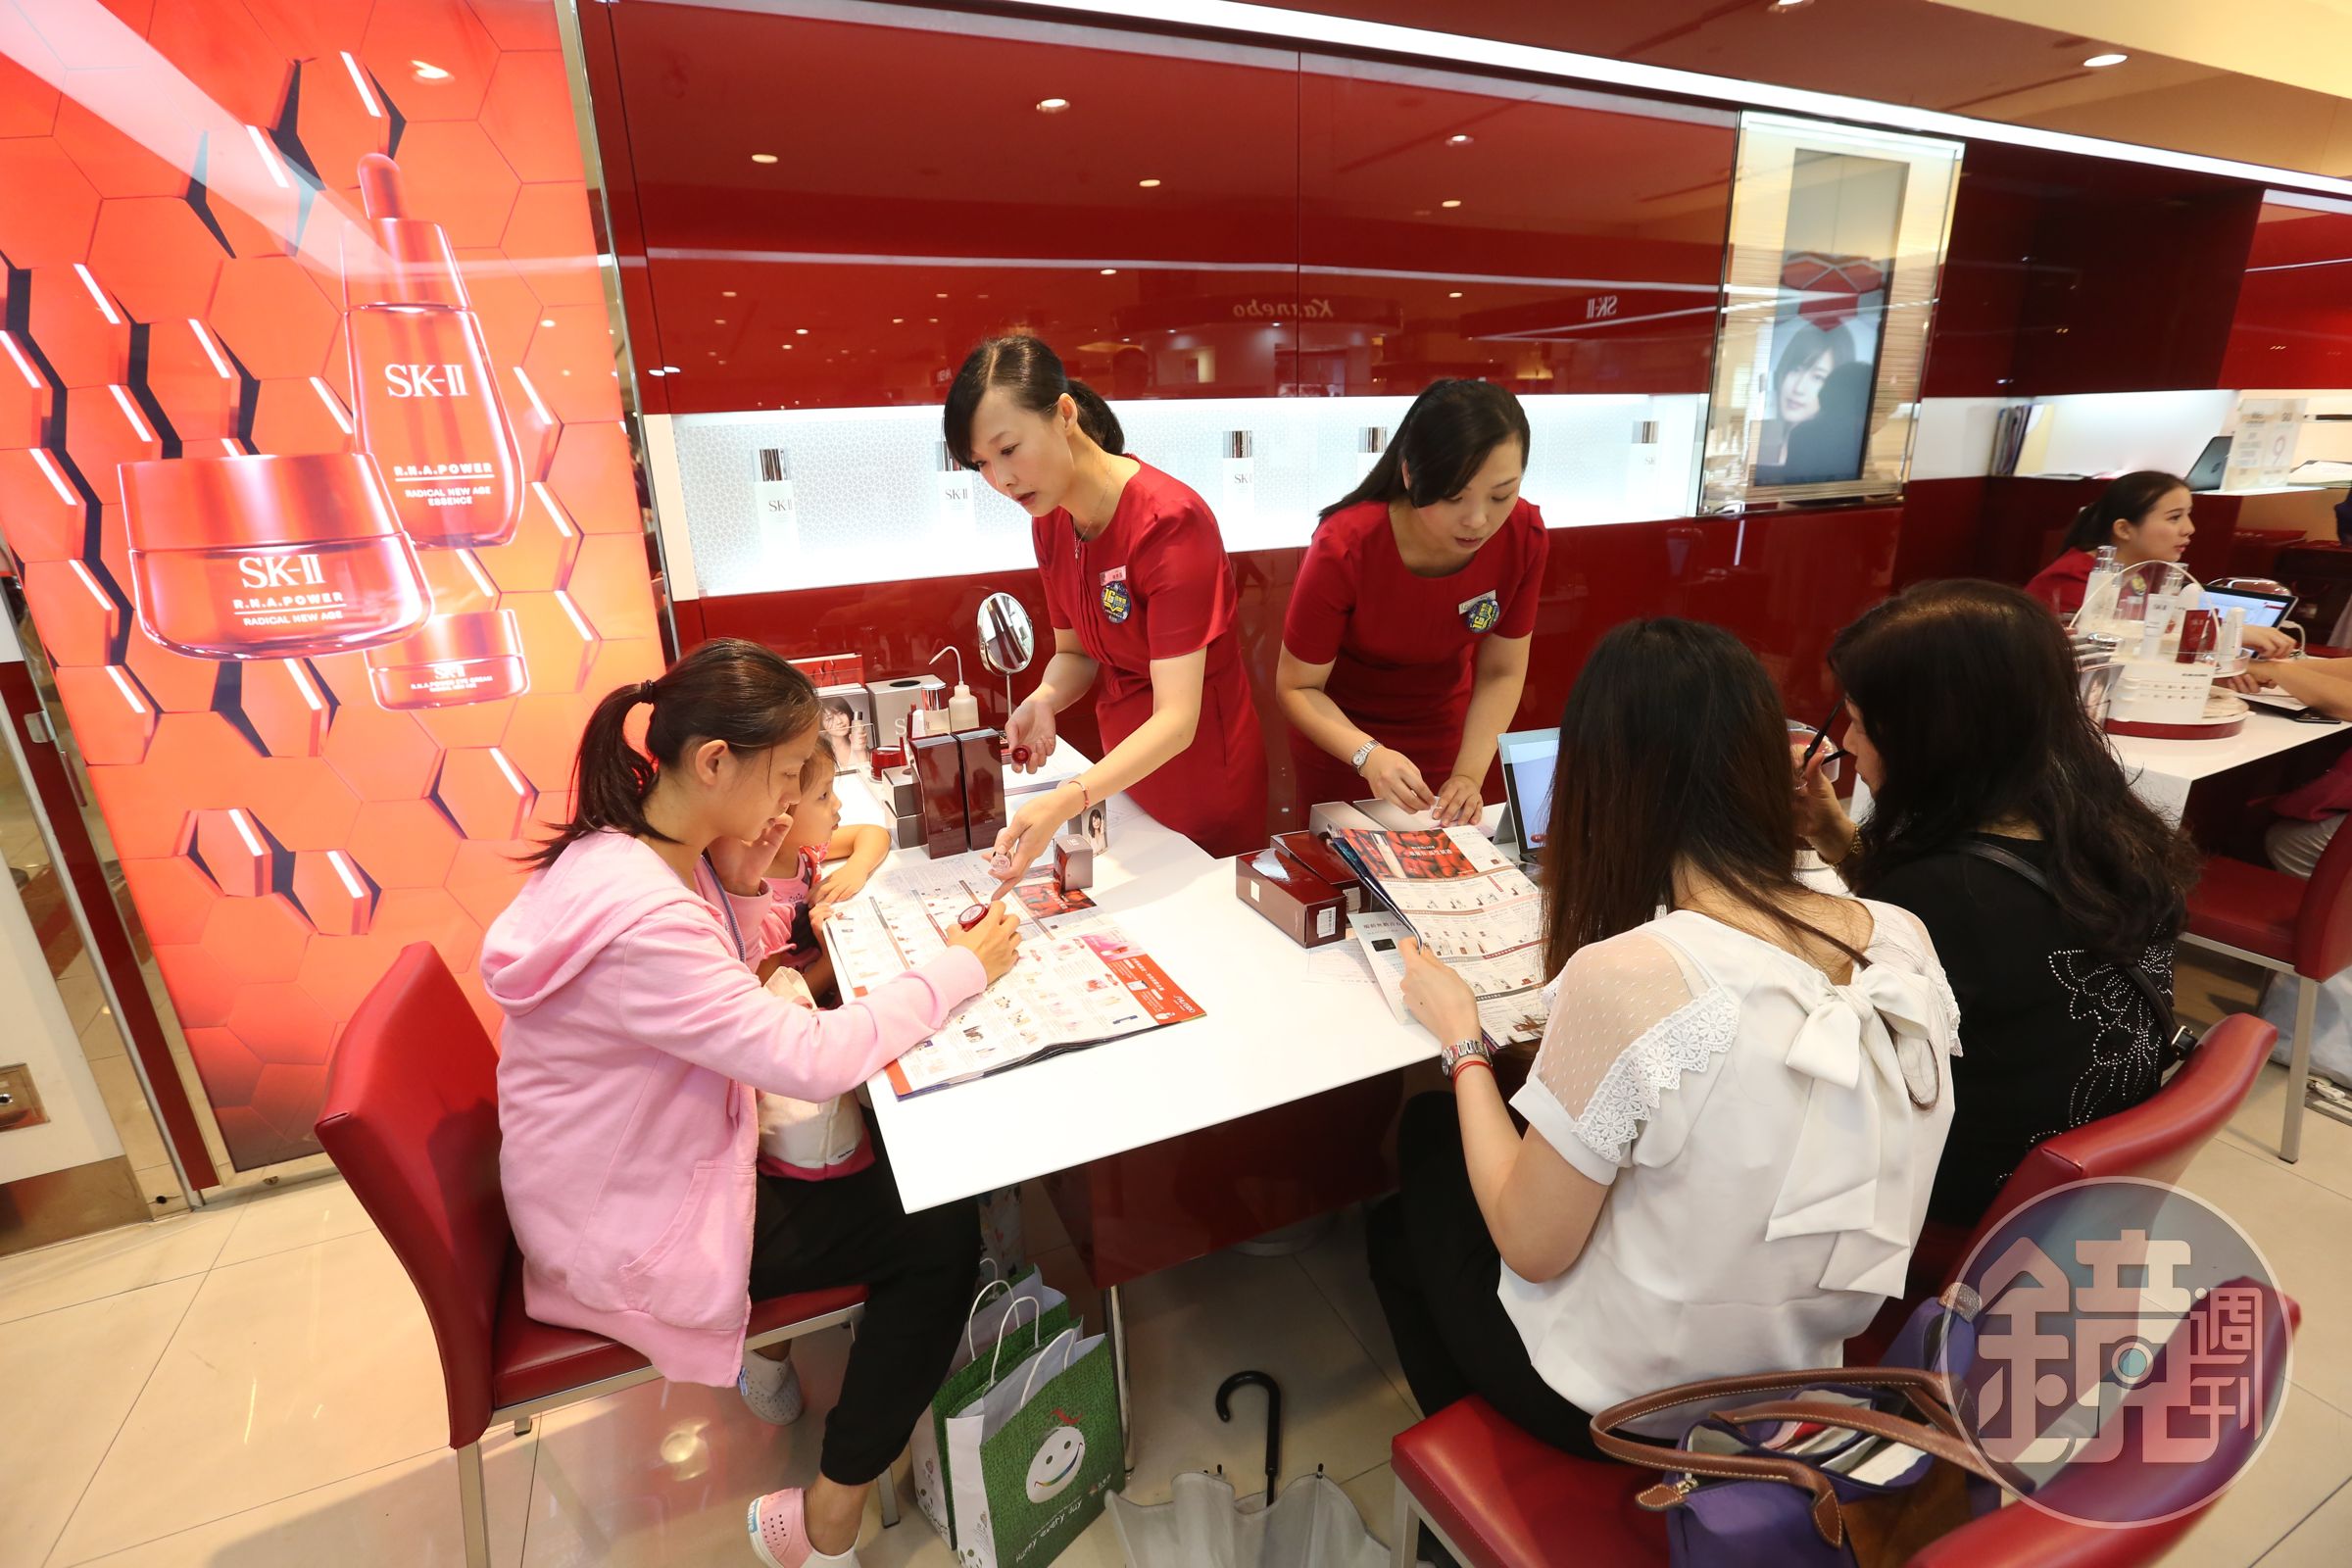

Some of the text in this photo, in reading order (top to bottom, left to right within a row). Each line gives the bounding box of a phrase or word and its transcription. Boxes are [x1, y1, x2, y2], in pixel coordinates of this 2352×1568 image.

[384, 364, 469, 398] SK-II
[405, 486, 492, 498] RADICAL NEW AGE
[427, 496, 473, 507] ESSENCE
[238, 554, 326, 589] SK-II
[243, 610, 344, 626] RADICAL NEW AGE
